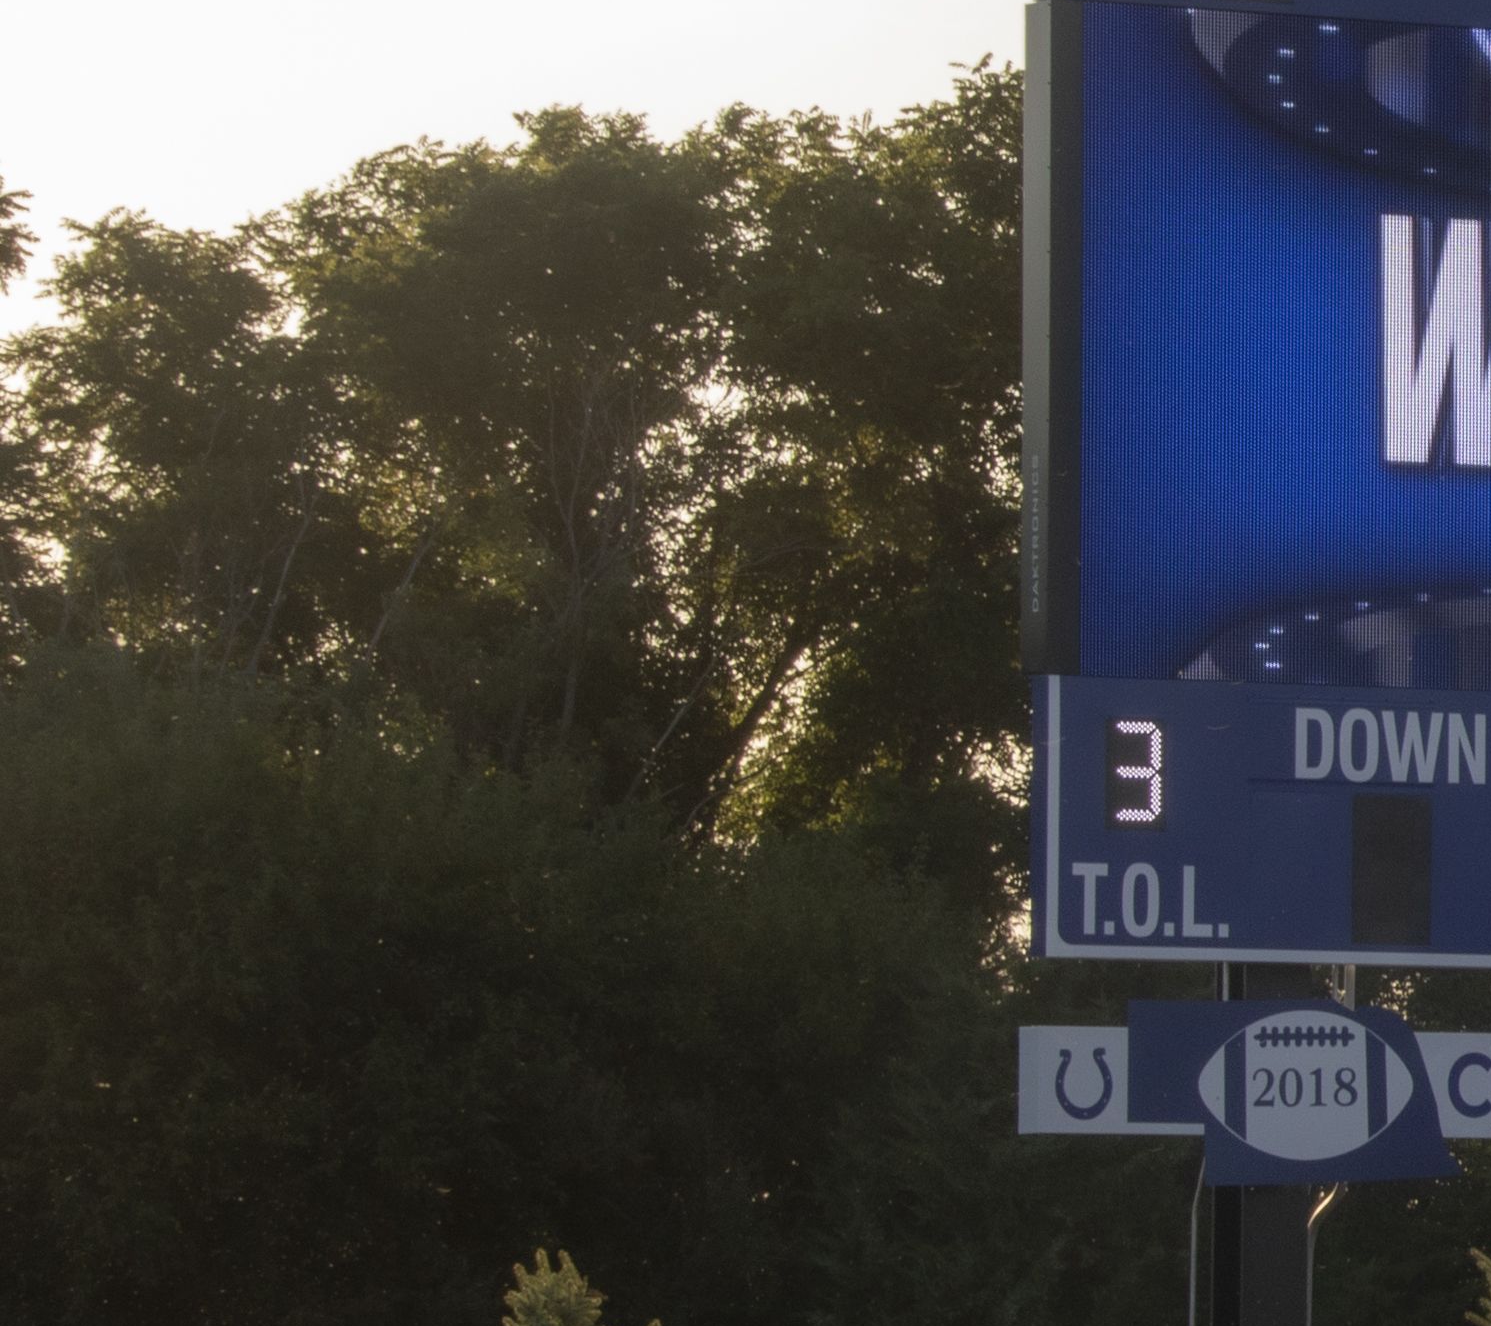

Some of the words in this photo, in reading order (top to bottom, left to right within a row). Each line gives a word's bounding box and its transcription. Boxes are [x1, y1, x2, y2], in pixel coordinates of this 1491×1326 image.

[1031, 455, 1039, 613] DAKTRONICS
[1115, 720, 1162, 822] 3
[1294, 707, 1488, 785] DOWN
[1071, 861, 1231, 939] T.O.L.
[1252, 1066, 1360, 1108] 2018
